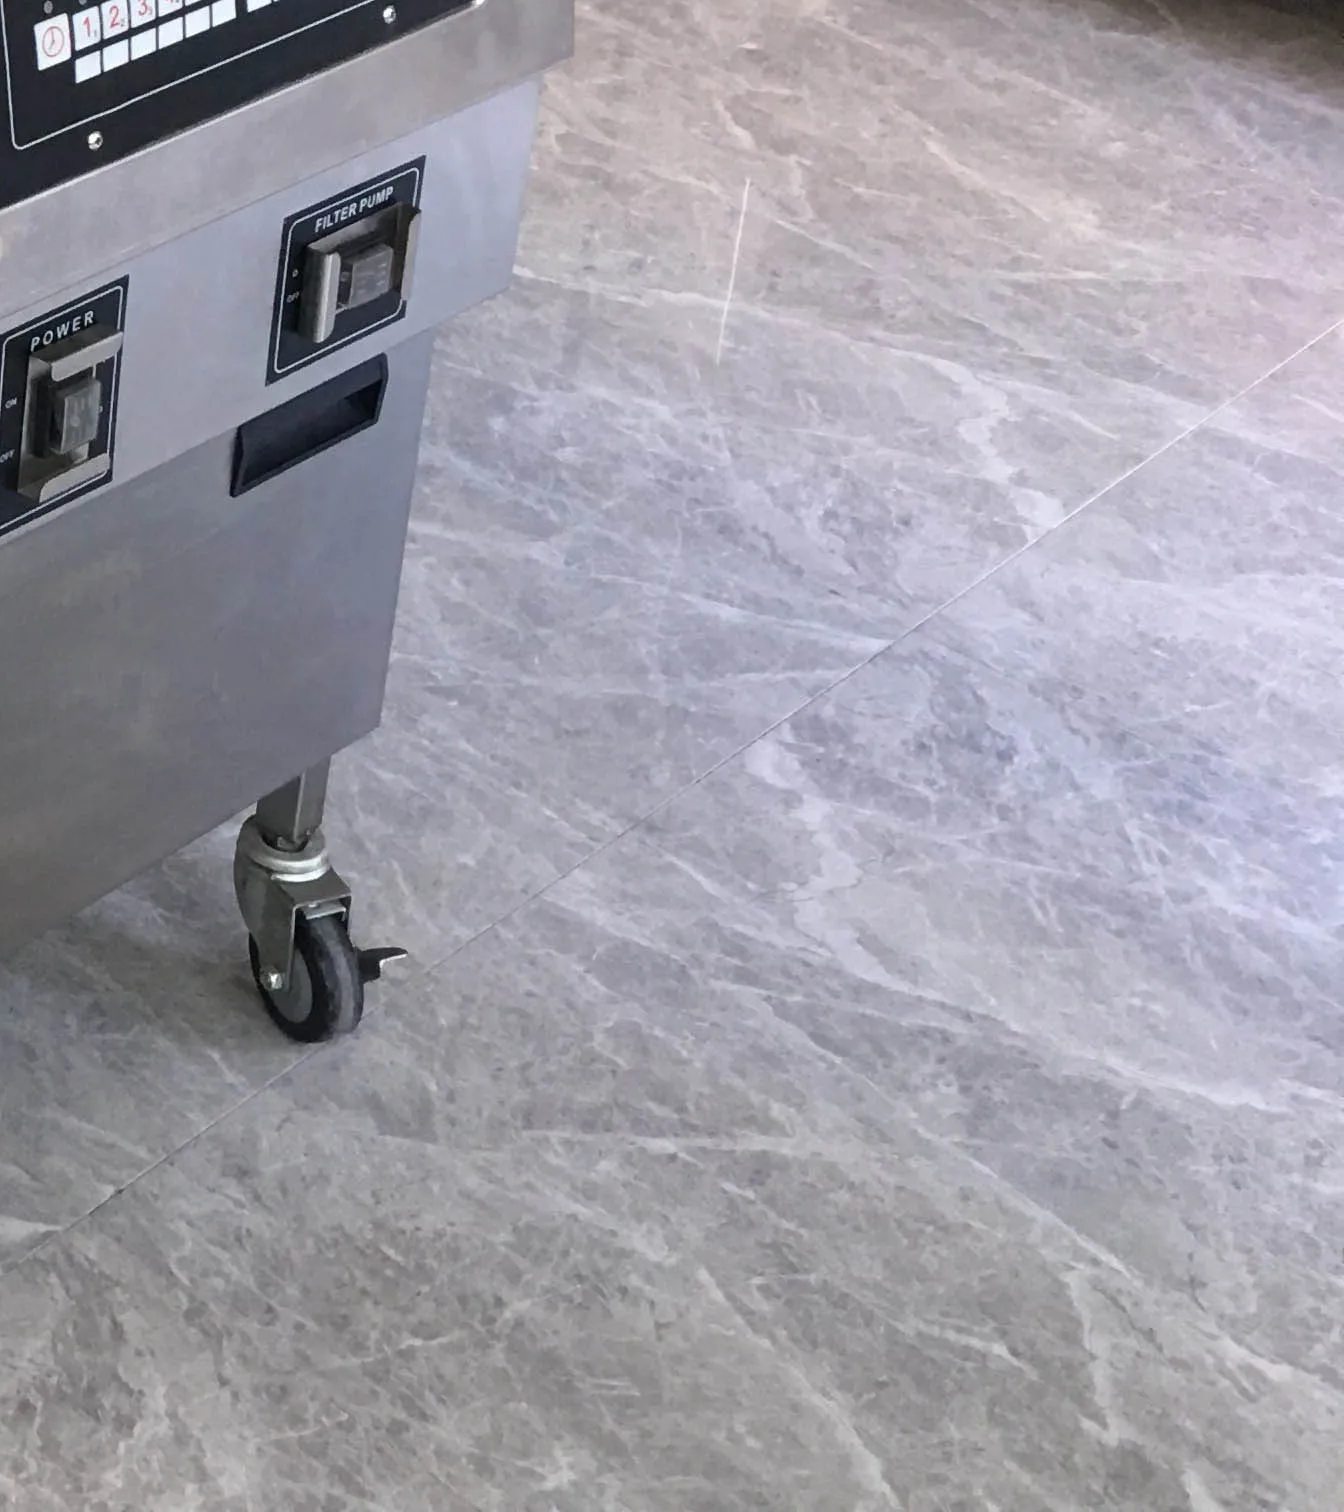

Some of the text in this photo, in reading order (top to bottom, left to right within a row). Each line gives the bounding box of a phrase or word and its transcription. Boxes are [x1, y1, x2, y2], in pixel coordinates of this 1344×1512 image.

[83, 16, 92, 38] 1
[109, 4, 120, 29] 2
[314, 186, 394, 233] FILTER PUMP
[30, 310, 95, 352] POWER
